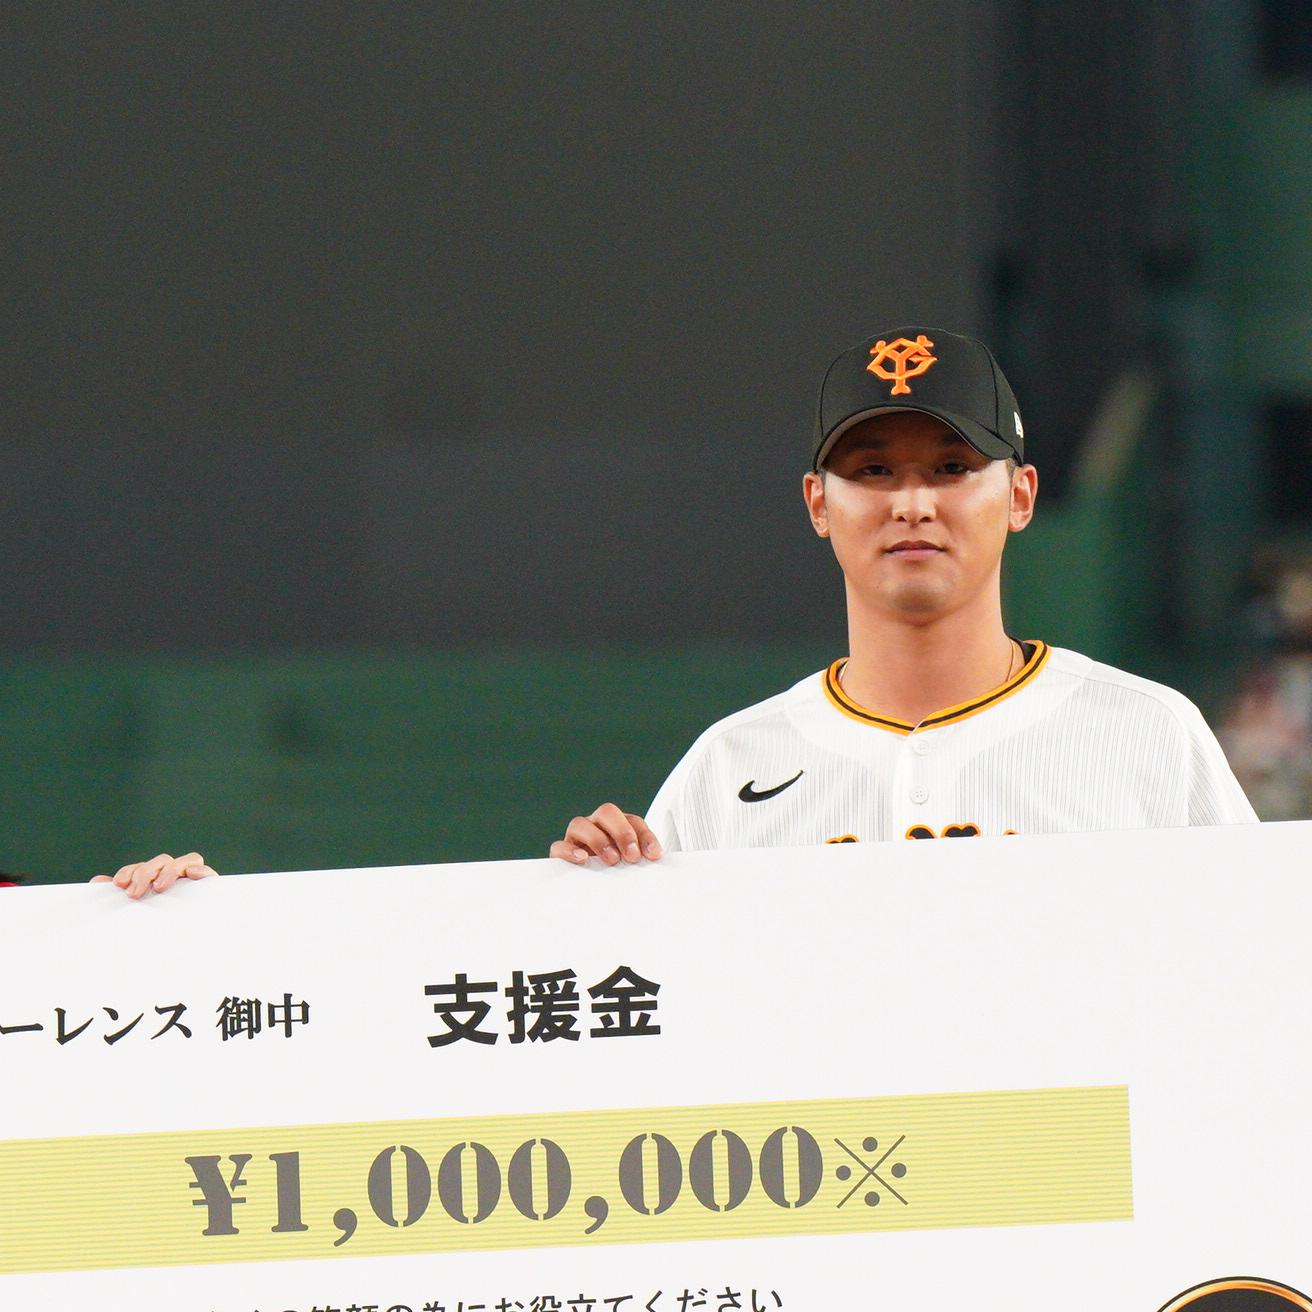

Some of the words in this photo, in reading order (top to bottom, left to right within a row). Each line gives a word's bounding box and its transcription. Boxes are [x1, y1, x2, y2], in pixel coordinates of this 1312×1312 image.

[215, 992, 311, 1042] 御中
[424, 965, 661, 1049] 支援金
